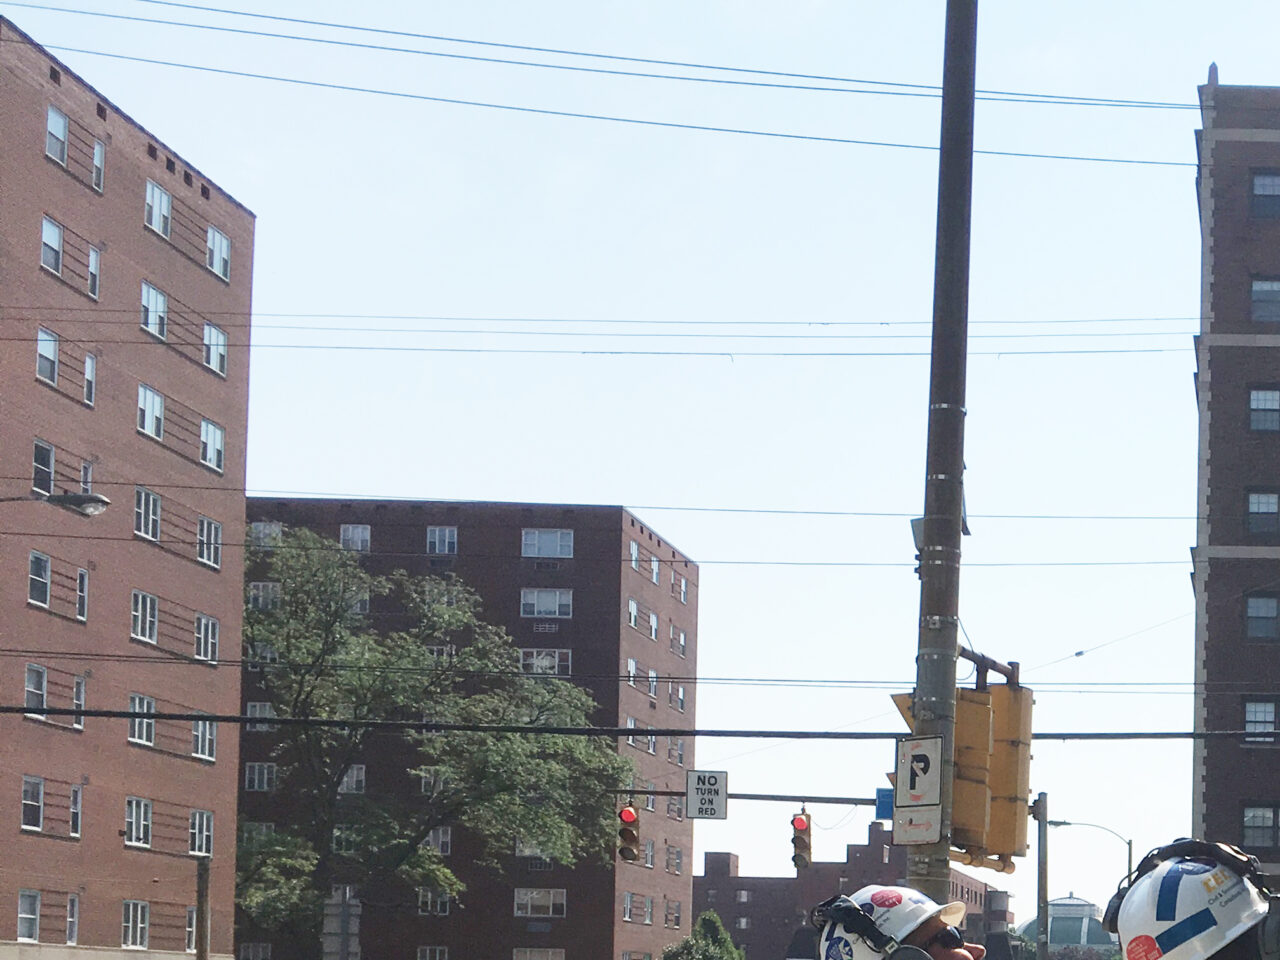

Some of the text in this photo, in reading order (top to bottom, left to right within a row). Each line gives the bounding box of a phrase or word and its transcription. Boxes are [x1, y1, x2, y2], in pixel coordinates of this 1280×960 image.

[909, 753, 931, 791] P
[697, 775, 718, 786] NO
[695, 787, 719, 796] TURN
[700, 798, 714, 806] ON
[698, 807, 716, 816] RED
